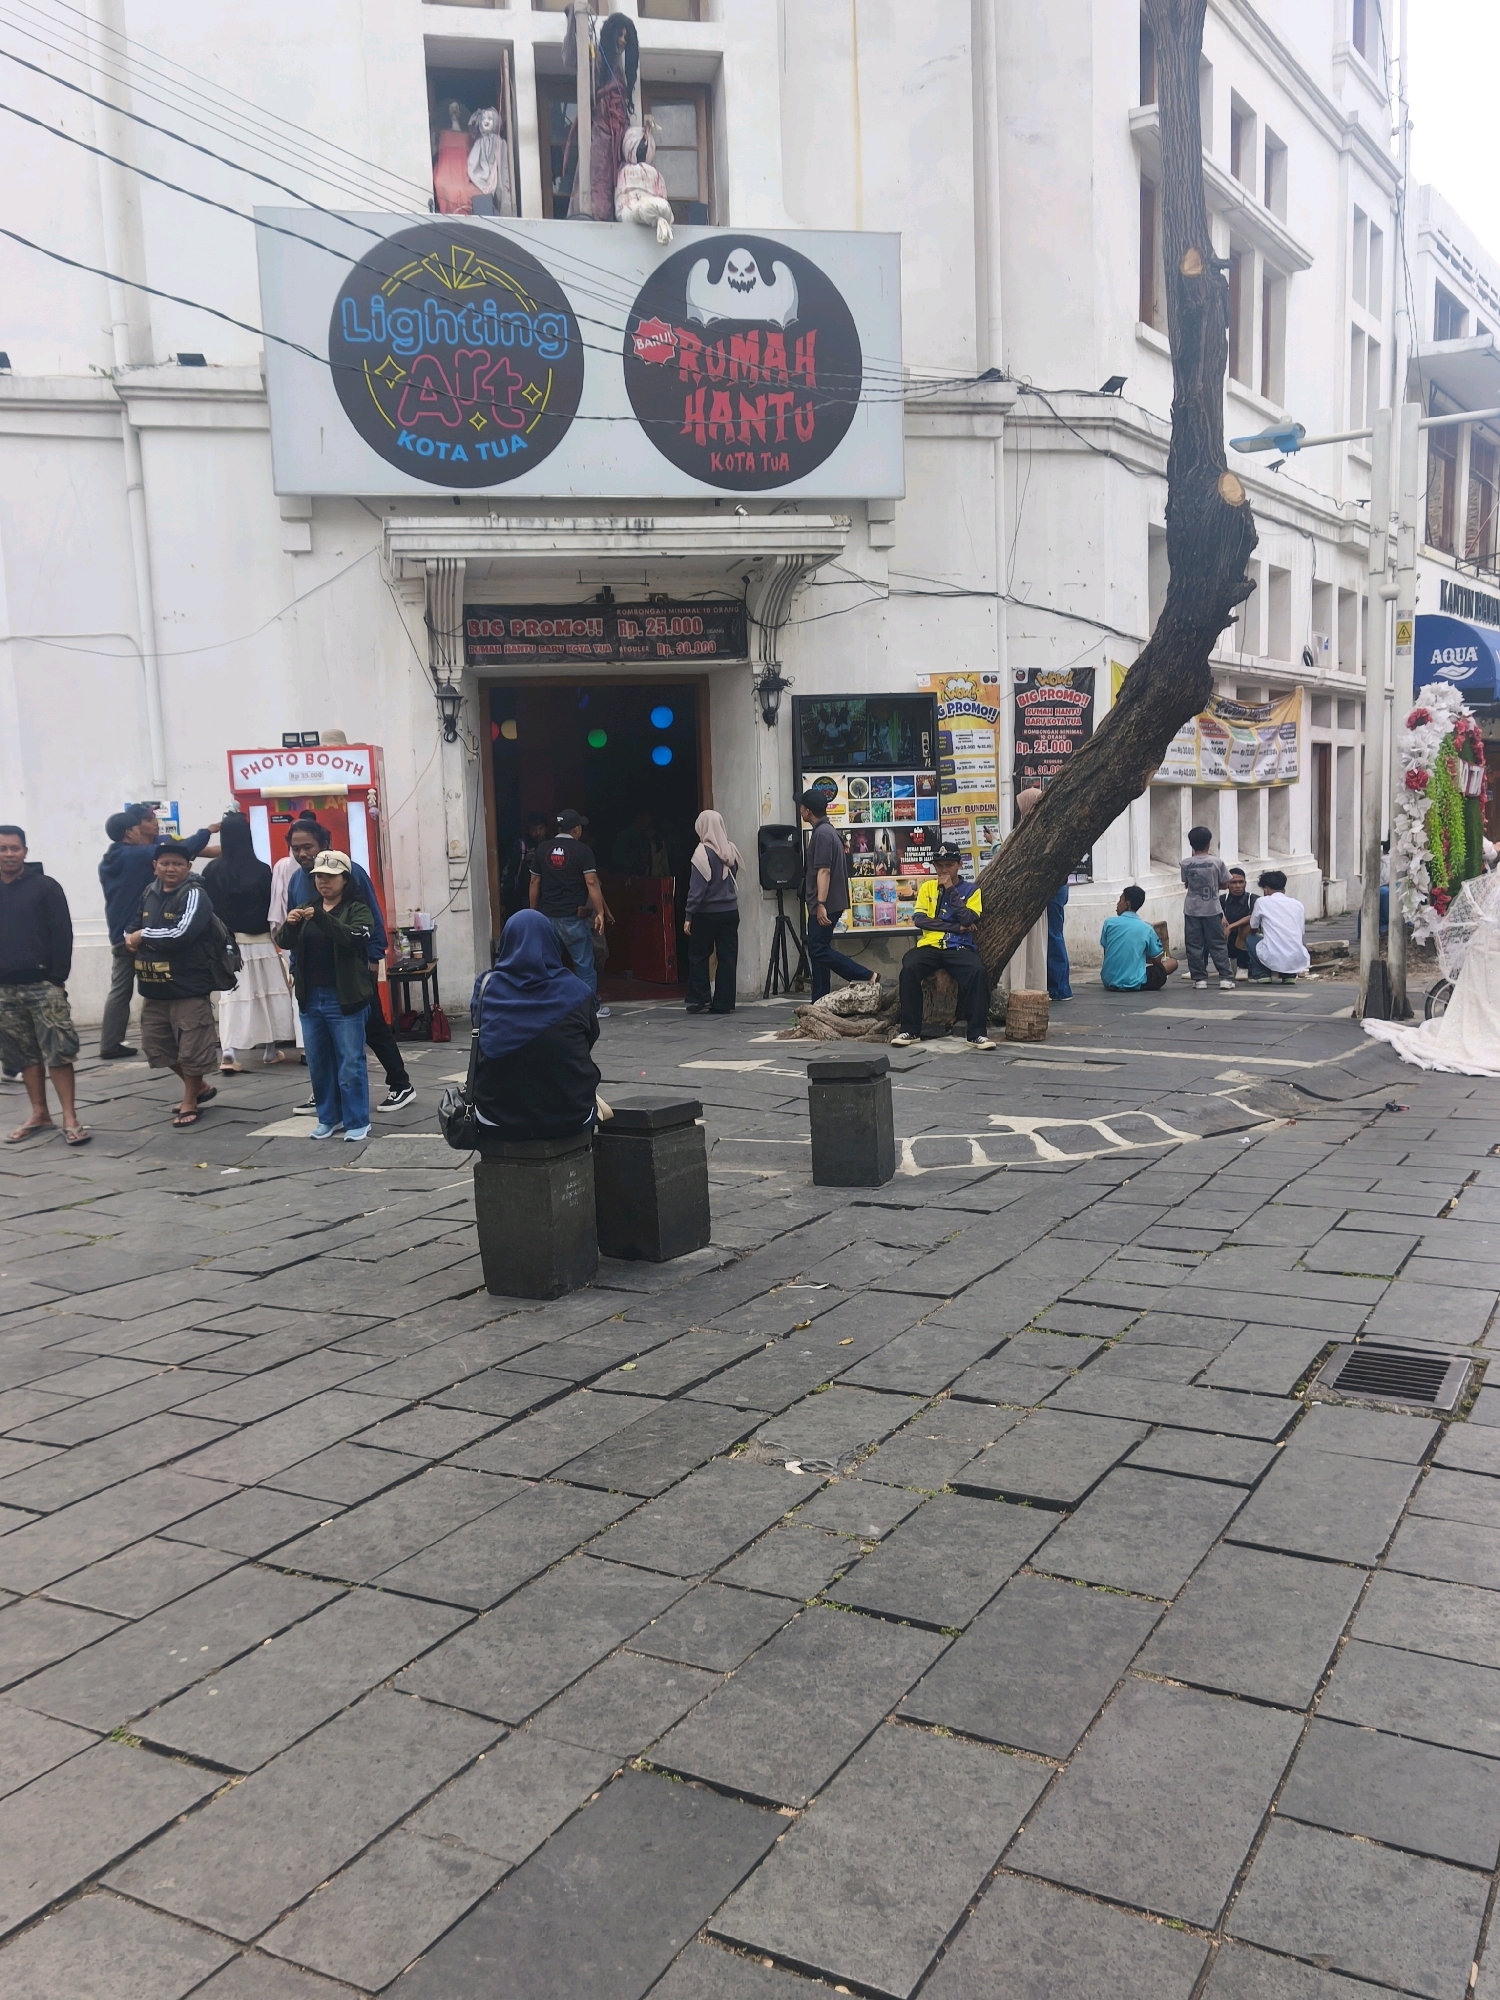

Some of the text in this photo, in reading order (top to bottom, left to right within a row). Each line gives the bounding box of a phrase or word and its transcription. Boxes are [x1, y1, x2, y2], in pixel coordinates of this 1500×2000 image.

[341, 295, 568, 360] Lighting
[635, 331, 672, 350] BARU!
[673, 326, 818, 389] RUMAH
[397, 349, 525, 428] Art
[679, 386, 815, 446] HANTU
[396, 430, 528, 462] KOTA TUA
[710, 452, 790, 473] KOTA TUA
[616, 608, 667, 616] ROMBONGAN
[713, 606, 739, 614] ORANG
[467, 618, 603, 637] BIG PROMO!!
[645, 616, 703, 636] 25.000
[469, 643, 612, 654] RUMAH HANTU BARU KOTA TUA
[676, 640, 716, 654] 30.000
[1430, 646, 1478, 665] AQUA
[1036, 671, 1074, 687] WOW!
[1016, 688, 1091, 708] BIG PROMO!!
[947, 701, 999, 723] PROMO!!
[1025, 708, 1082, 716] RUMAH HANTU
[1025, 717, 1082, 725] BARU KOTA TUA
[1034, 740, 1072, 754] 25.000
[239, 753, 364, 780] PHOTO BOOTH
[1037, 765, 1063, 775] 30.00
[941, 803, 997, 815] AKET BUNDLIN
